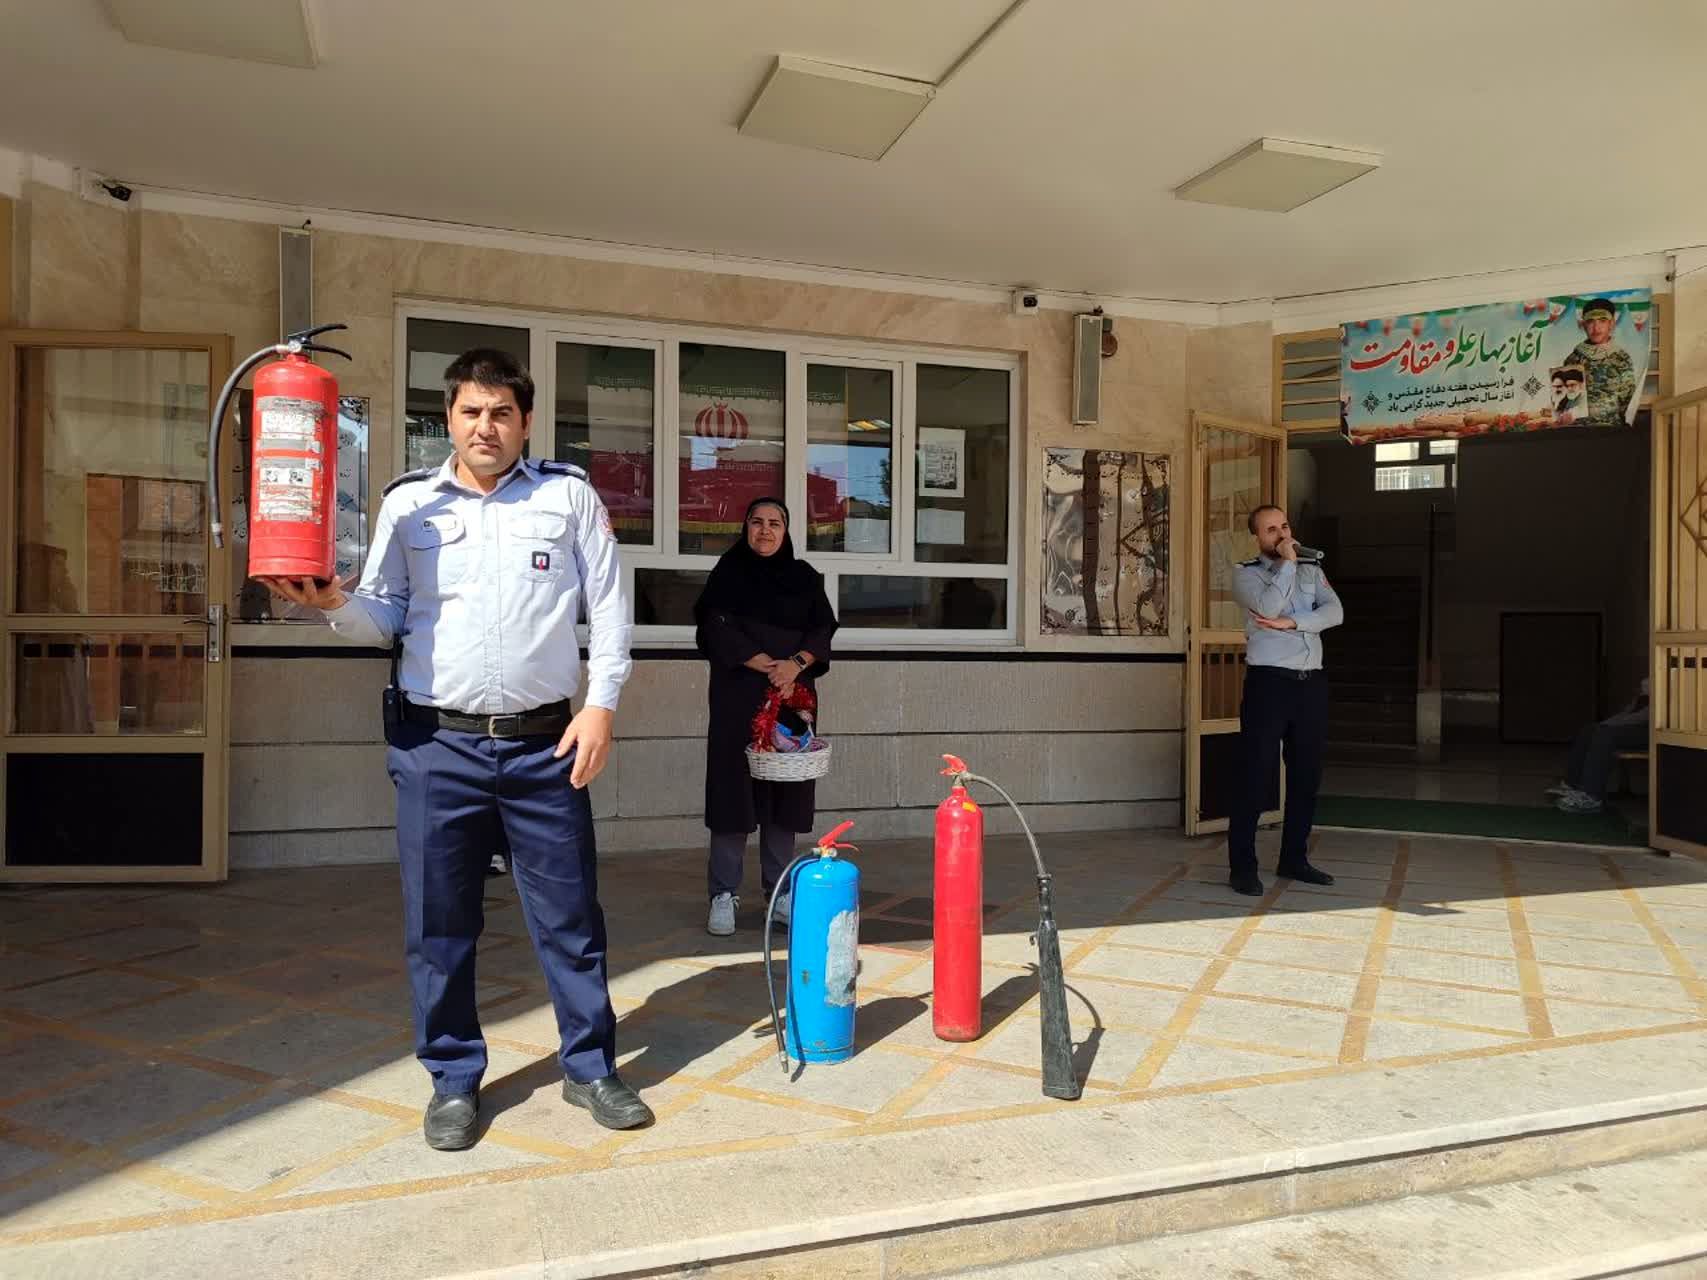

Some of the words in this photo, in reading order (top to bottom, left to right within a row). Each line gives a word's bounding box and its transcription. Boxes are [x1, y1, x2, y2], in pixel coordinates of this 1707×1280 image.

[1502, 319, 1551, 364] آغاز
[1443, 339, 1455, 360] و
[1444, 325, 1476, 372] علم
[1466, 329, 1506, 373] بهار
[1350, 338, 1441, 374] مقاومت
[1447, 382, 1468, 392] هفته
[1469, 379, 1500, 391] رسیدن
[1501, 377, 1514, 388] فرا
[1387, 392, 1393, 400] و
[1425, 384, 1446, 397] دفاع
[1480, 391, 1498, 403] سال
[1388, 402, 1398, 412] باد
[1399, 398, 1424, 412] گرامی
[1424, 400, 1446, 410] جدید
[1446, 394, 1479, 408] تحصیلی
